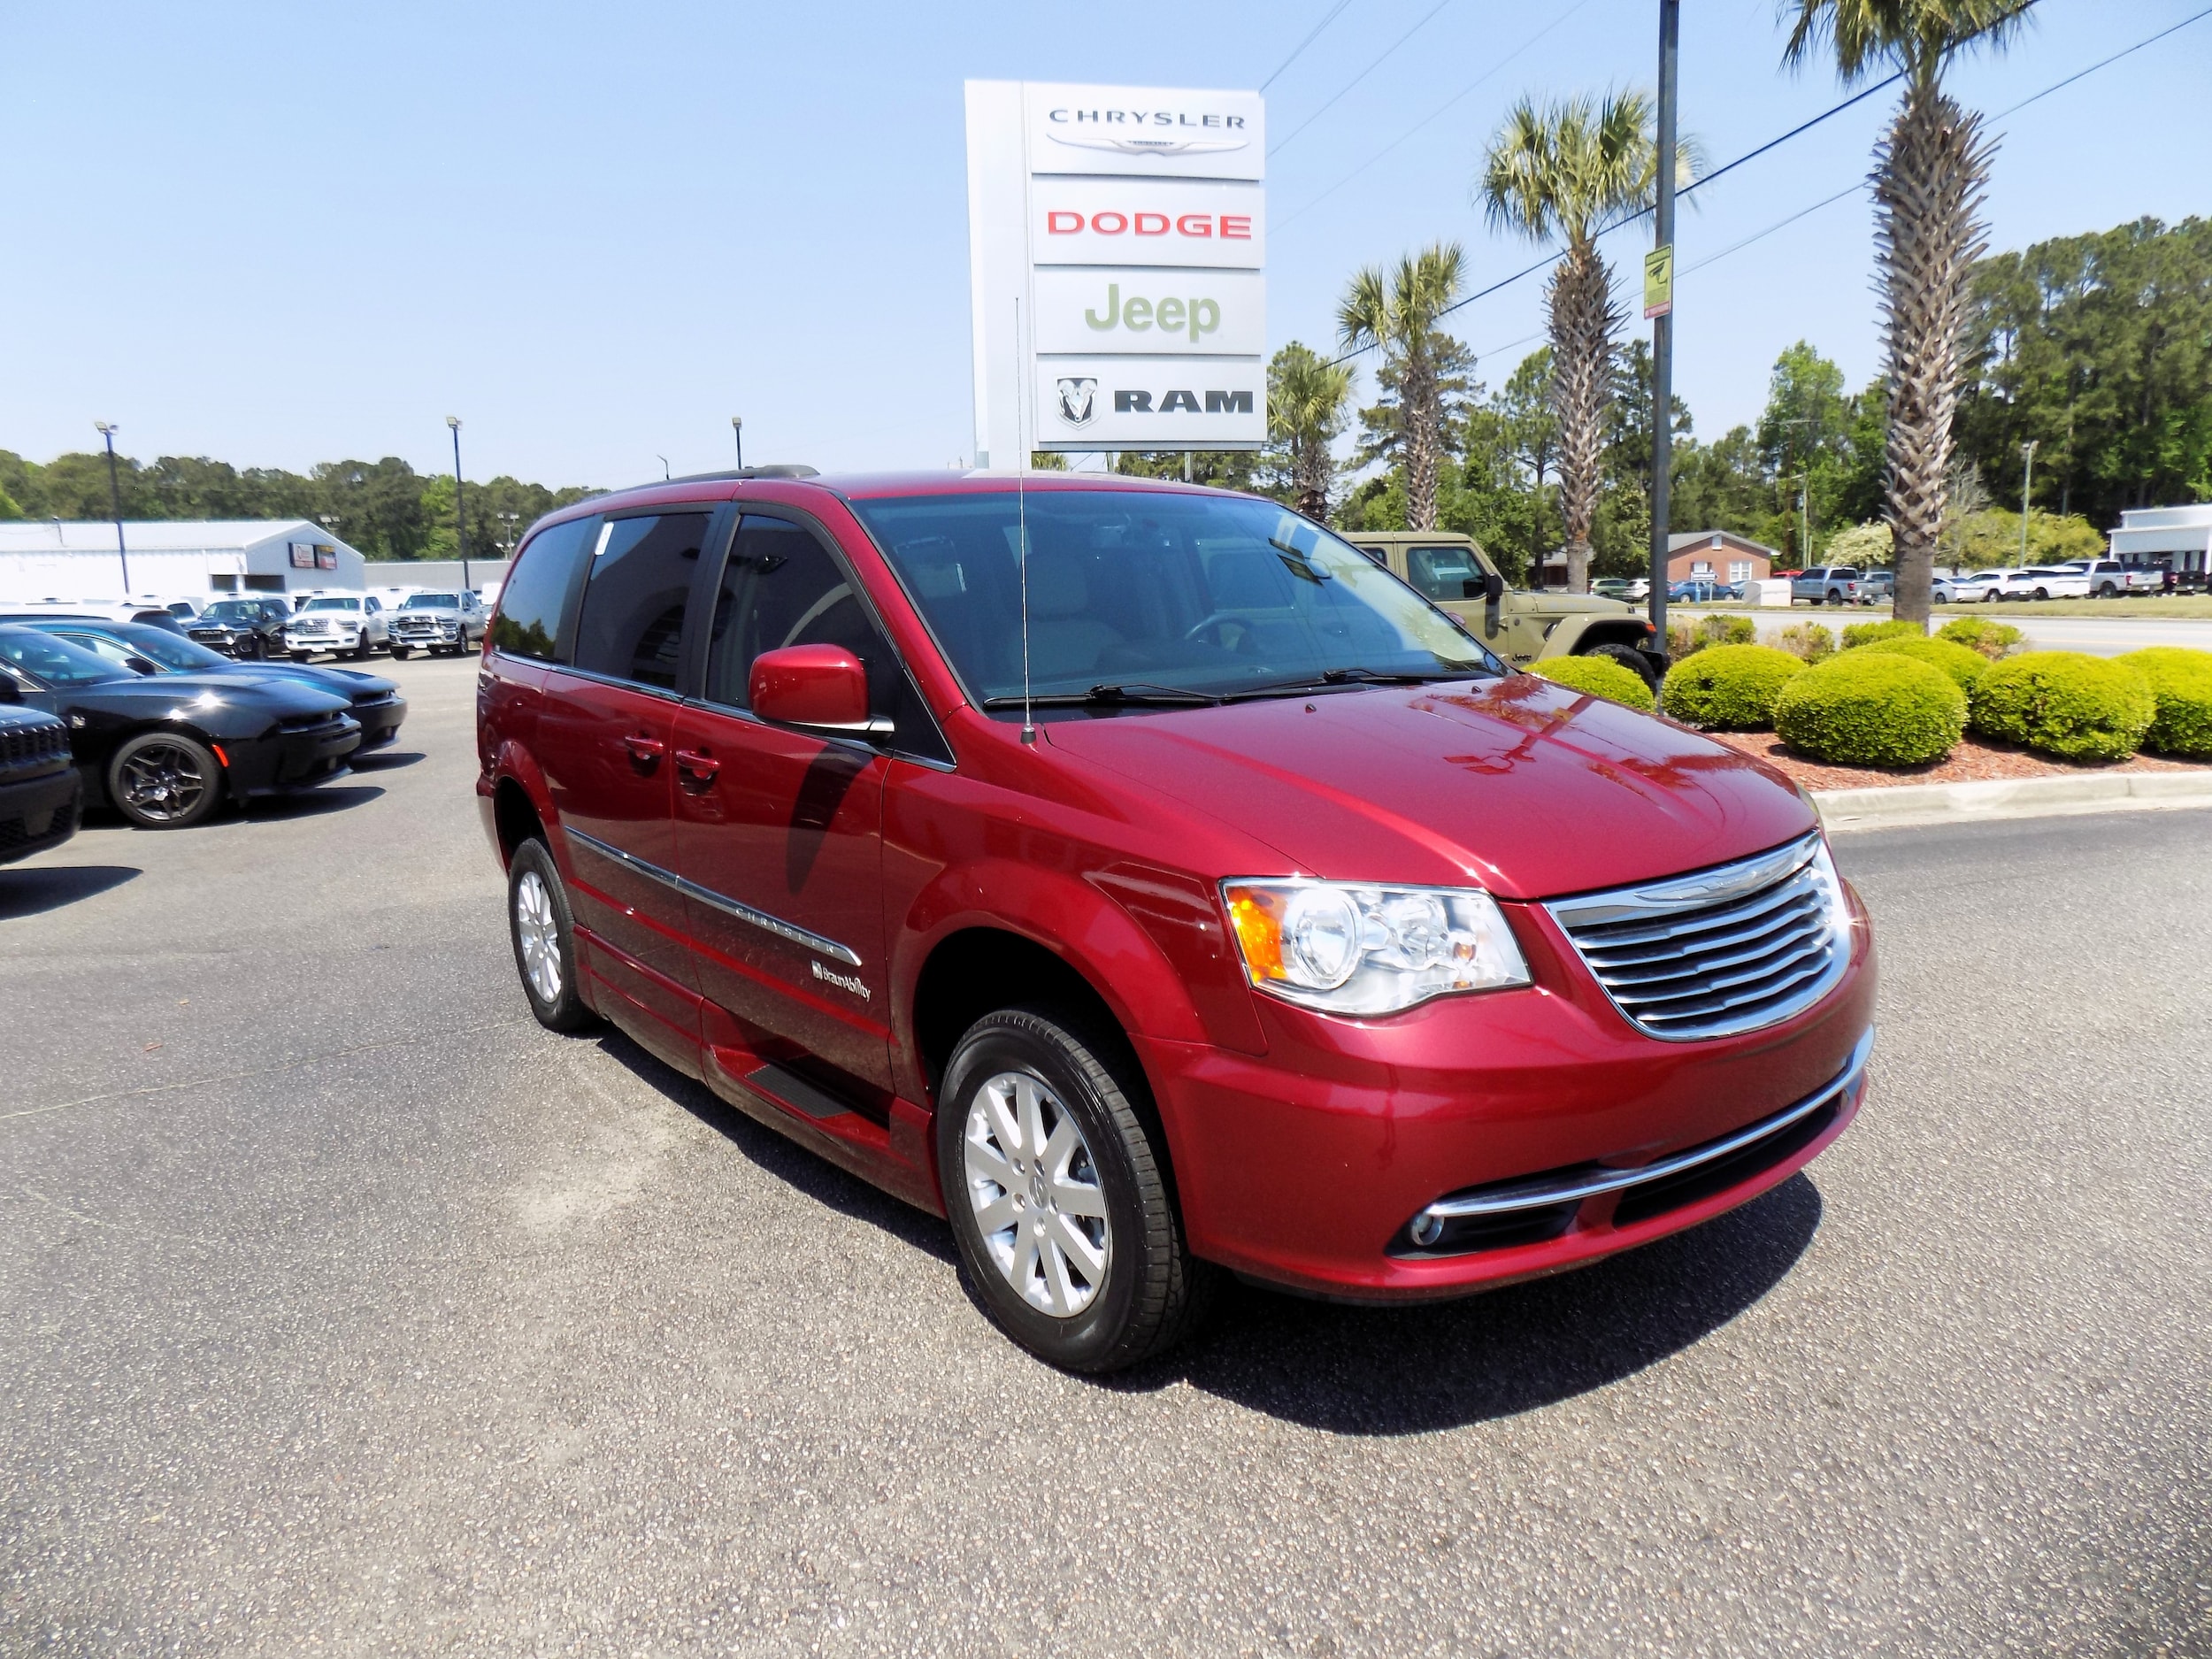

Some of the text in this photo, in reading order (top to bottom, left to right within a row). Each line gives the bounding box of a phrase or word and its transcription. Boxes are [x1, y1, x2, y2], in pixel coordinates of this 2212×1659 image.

[1049, 109, 1246, 129] CHRYSLER
[1048, 211, 1252, 240] DODGE
[1085, 283, 1220, 342] Jeep
[1114, 390, 1254, 413] RAM
[1511, 653, 1532, 663] Jeep
[735, 908, 834, 954] CHRYSLER
